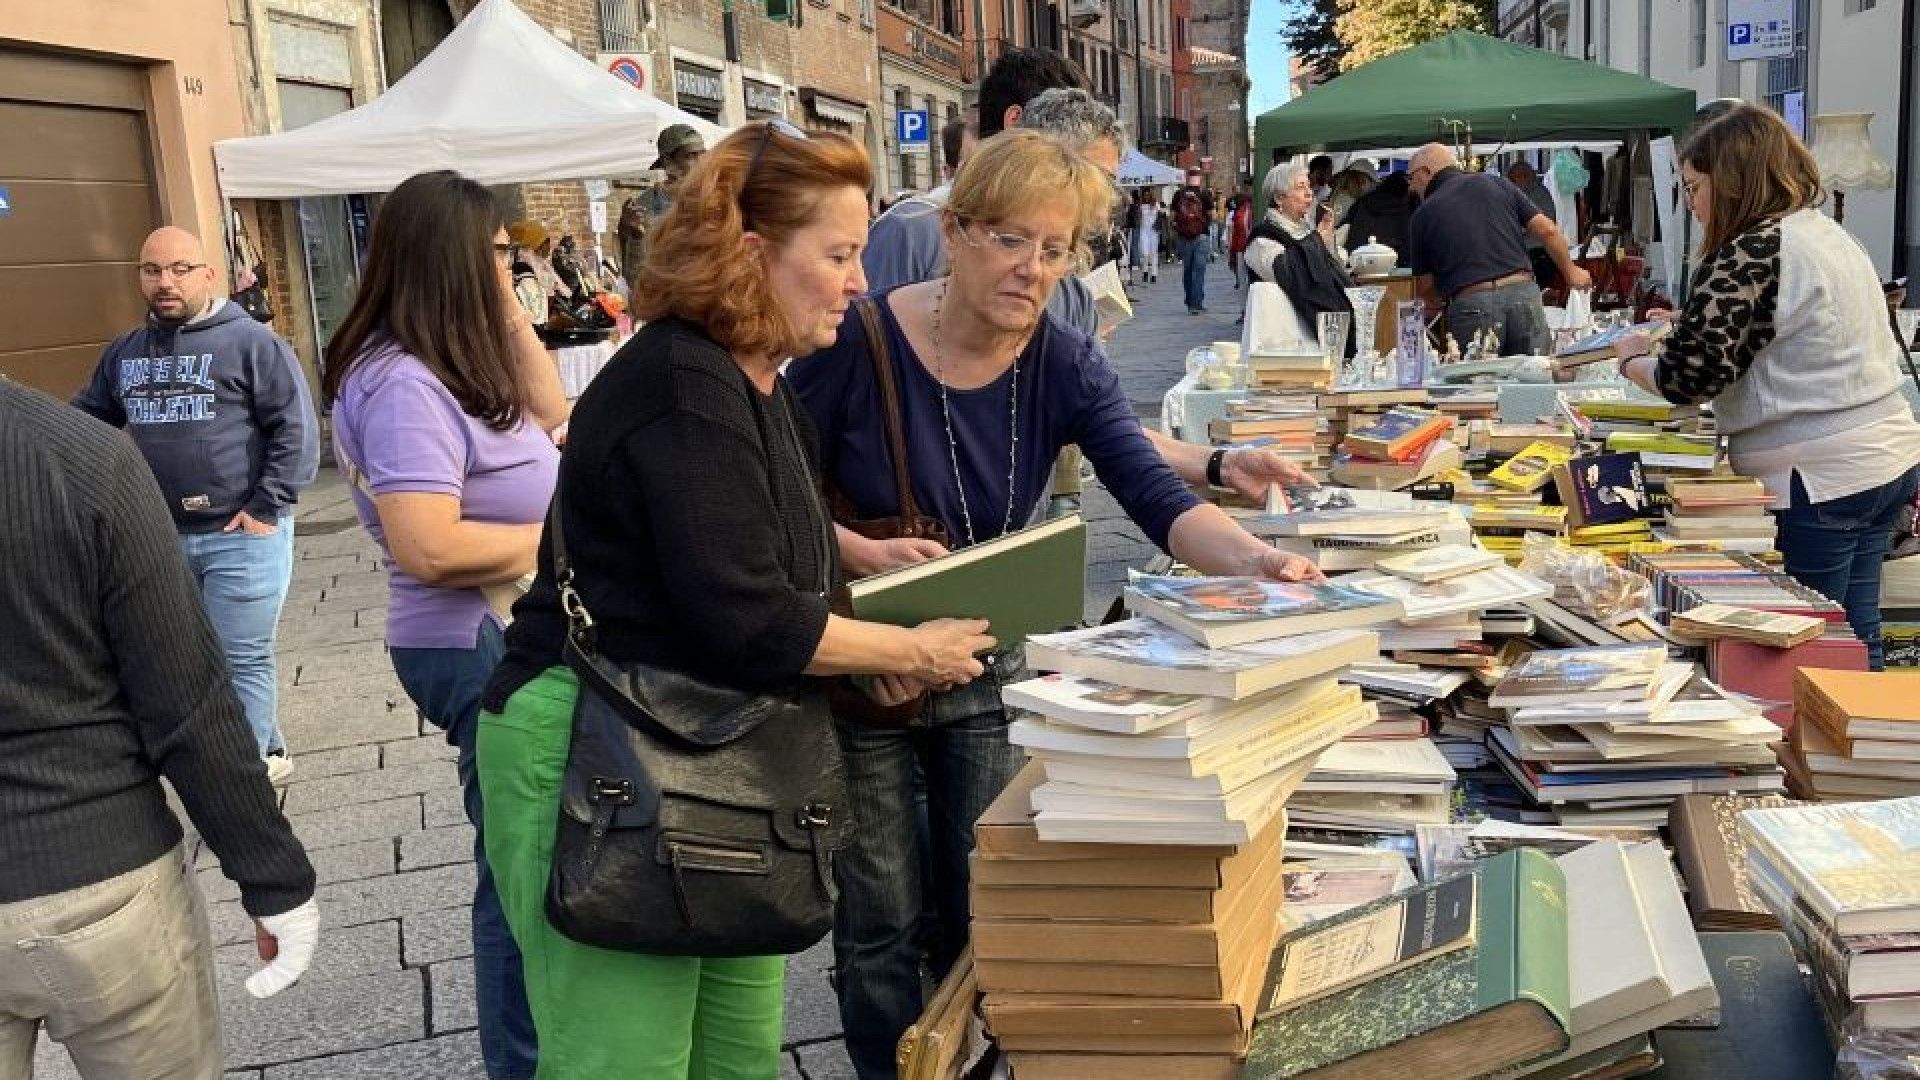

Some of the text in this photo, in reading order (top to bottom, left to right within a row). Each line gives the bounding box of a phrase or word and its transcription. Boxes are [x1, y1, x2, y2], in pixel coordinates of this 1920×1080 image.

[1733, 27, 1747, 43] P
[183, 75, 203, 96] 149
[903, 113, 922, 139] P
[120, 353, 215, 394] RUSSELL
